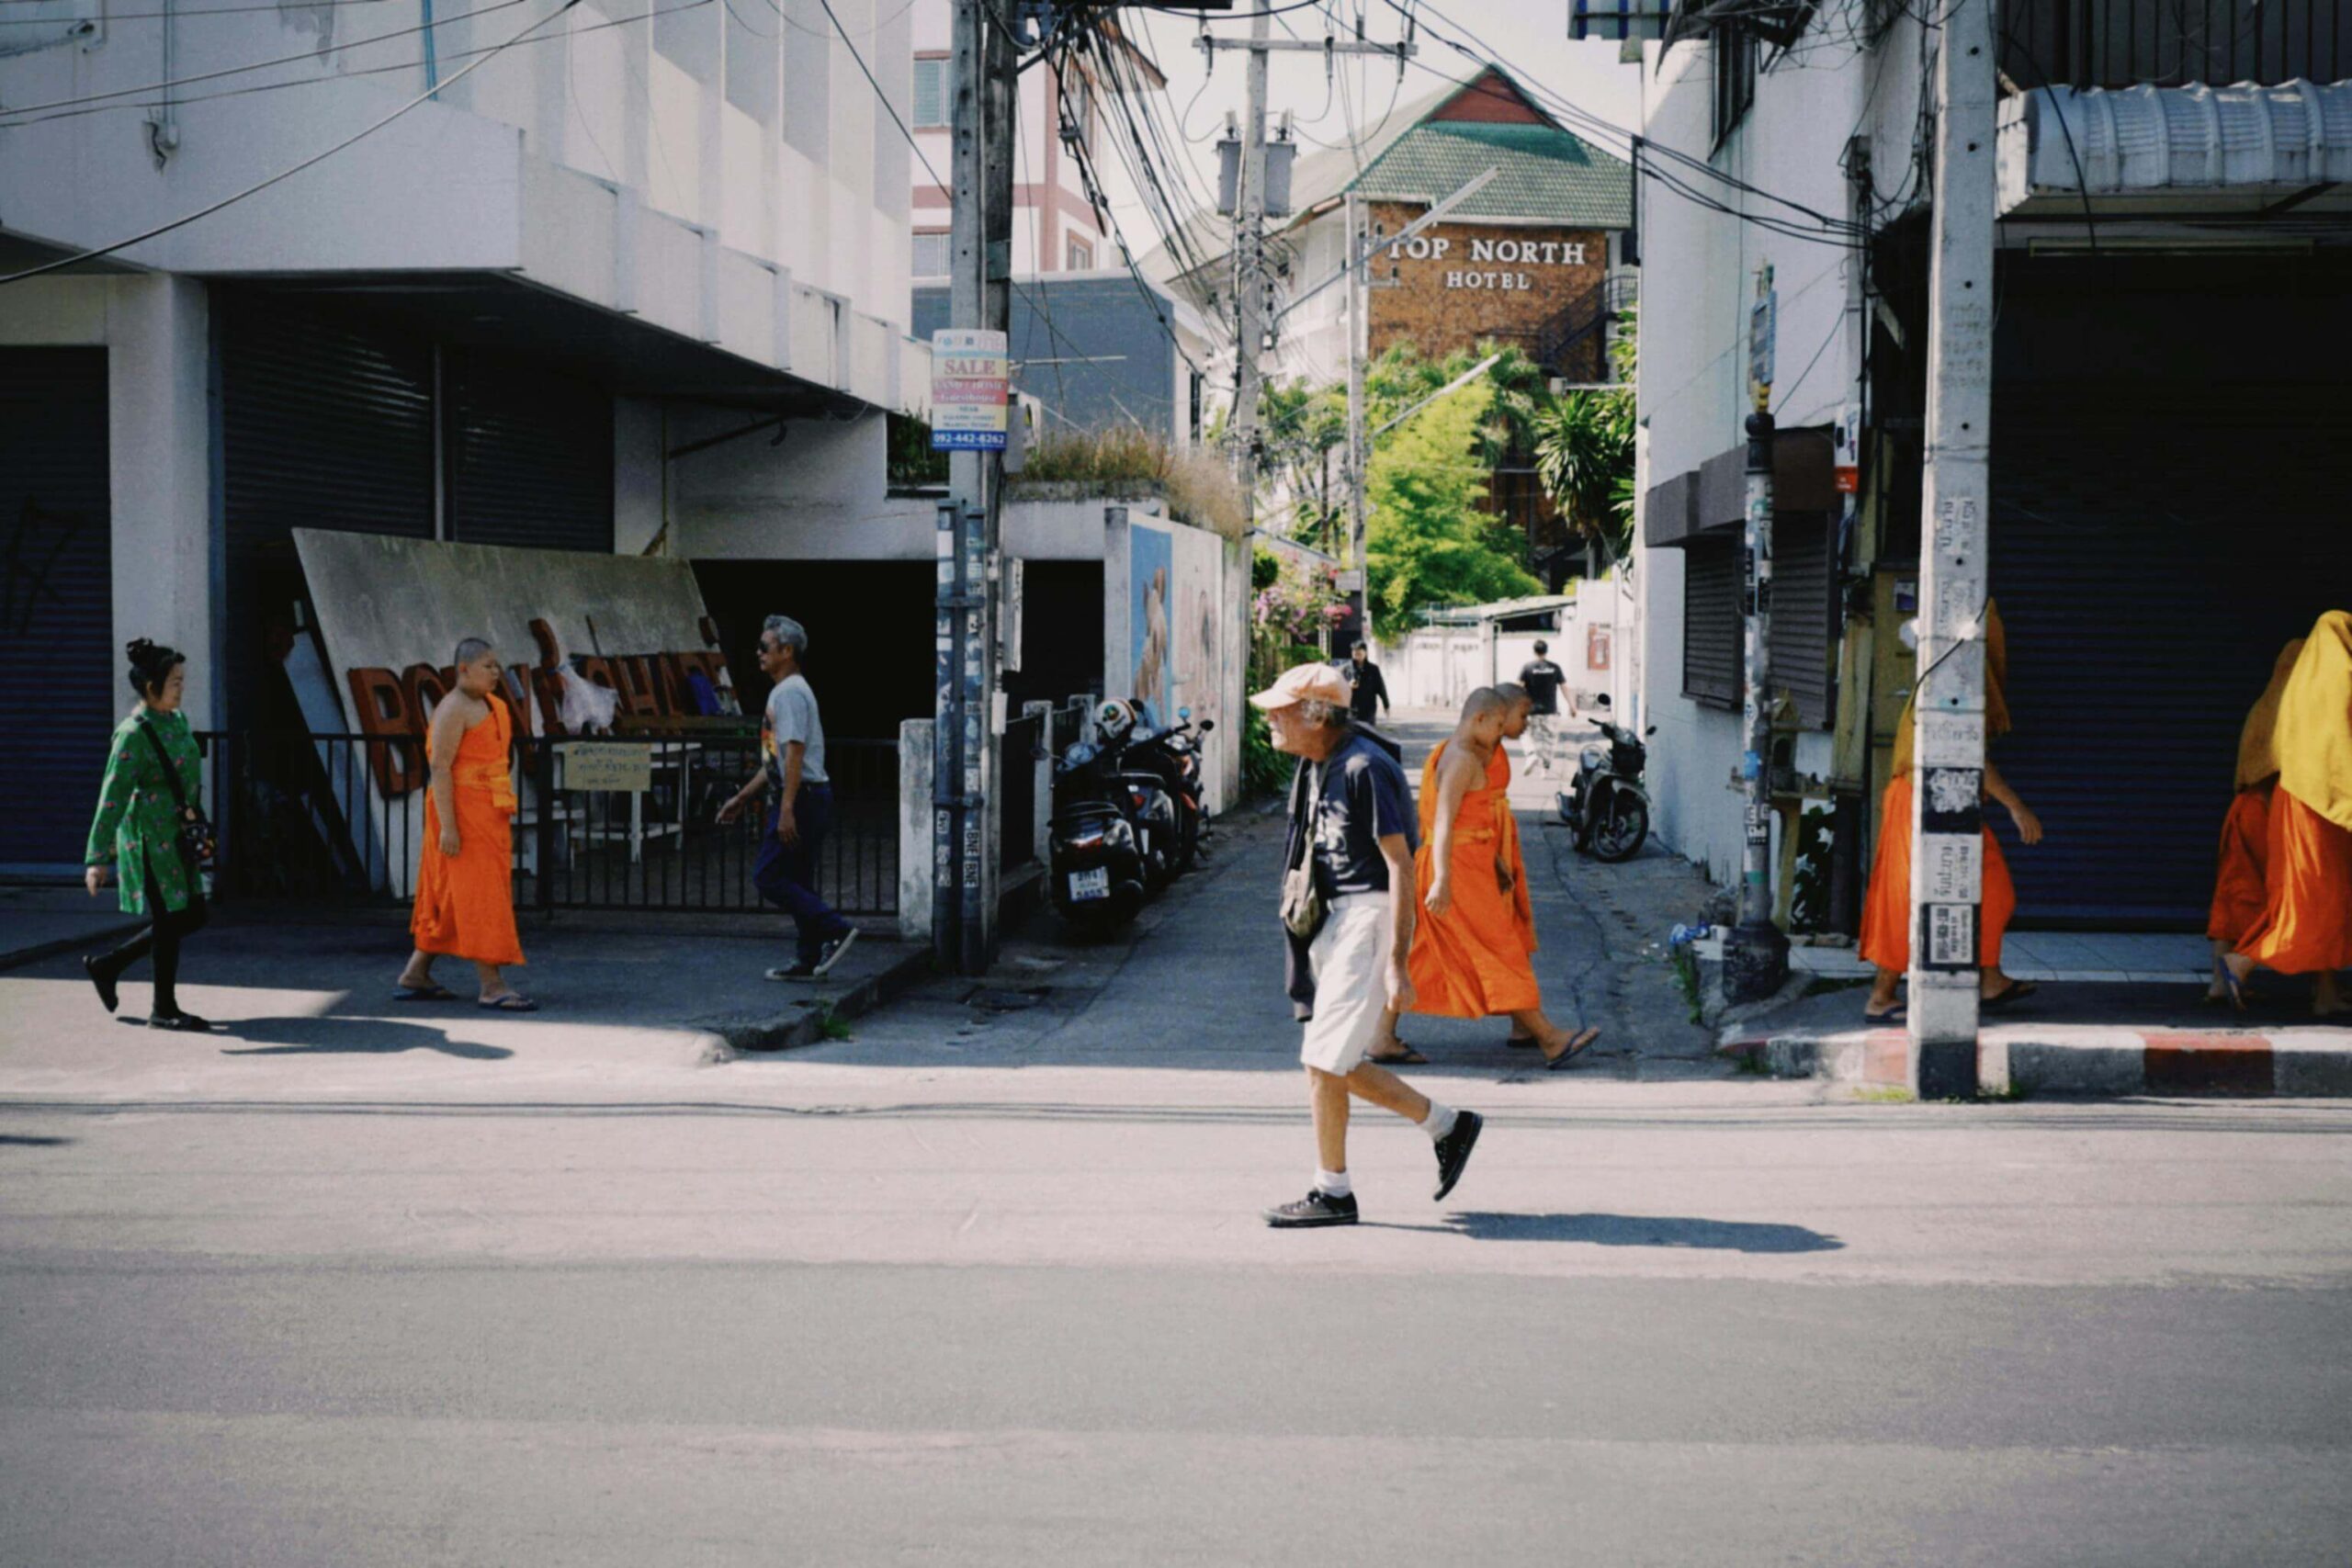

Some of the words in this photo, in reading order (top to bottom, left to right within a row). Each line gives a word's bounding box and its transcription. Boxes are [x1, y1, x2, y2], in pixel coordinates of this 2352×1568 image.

[1388, 237, 1450, 260] TOP
[1471, 239, 1586, 265] NORTH
[1446, 271, 1530, 289] HOTEL
[944, 359, 996, 375] SALE
[967, 832, 978, 853] BNE
[965, 863, 978, 885] BNE
